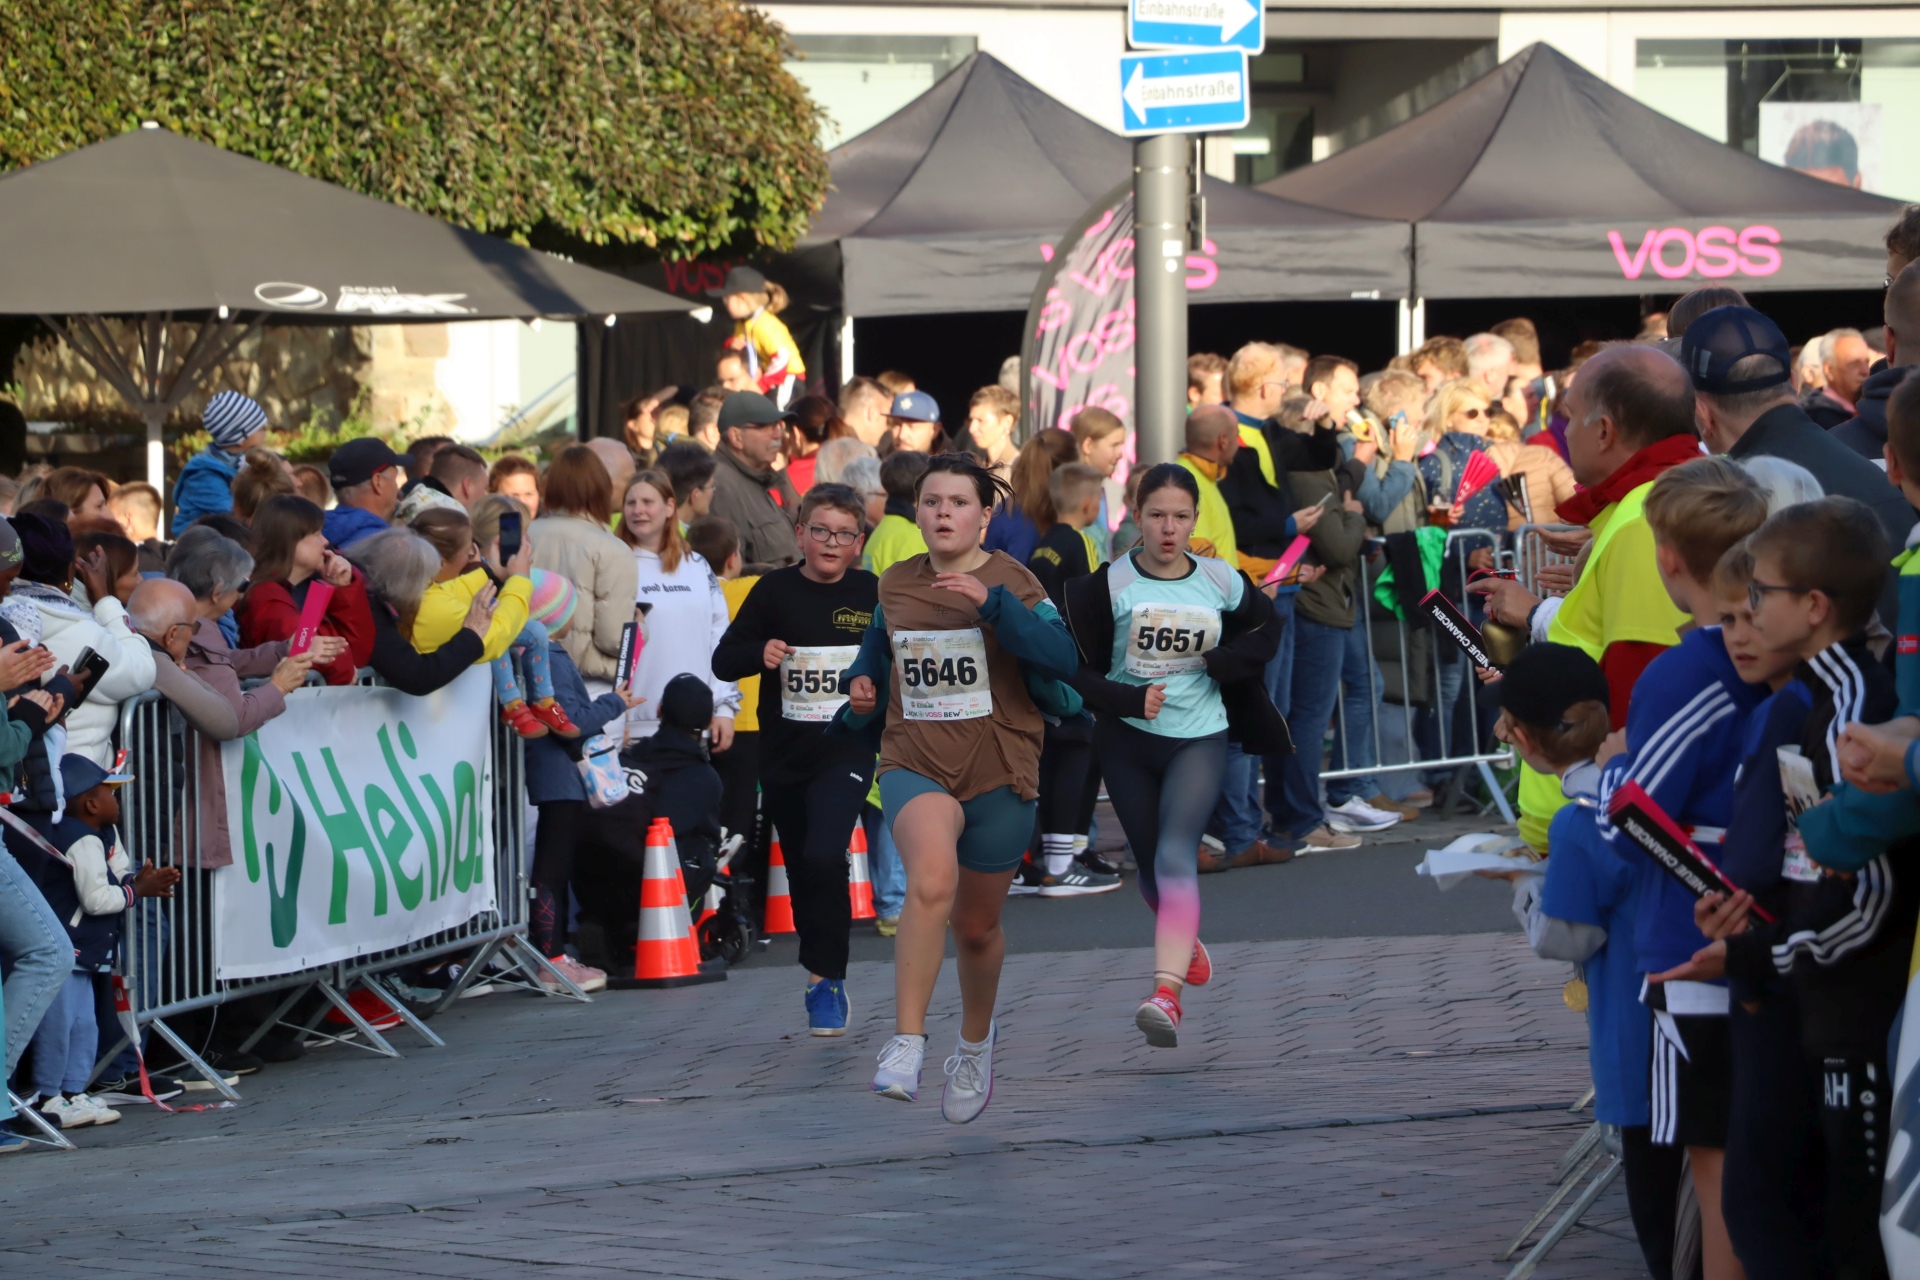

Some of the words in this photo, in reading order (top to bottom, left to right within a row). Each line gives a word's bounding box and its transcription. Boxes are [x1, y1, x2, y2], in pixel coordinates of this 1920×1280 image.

[1606, 224, 1783, 280] VOSS
[1137, 625, 1206, 653] 5651
[1431, 605, 1471, 647] CHANCEN.
[1467, 644, 1490, 668] NEUE
[903, 656, 978, 688] 5646
[943, 710, 961, 718] BEW
[1673, 862, 1708, 893] NEUE
